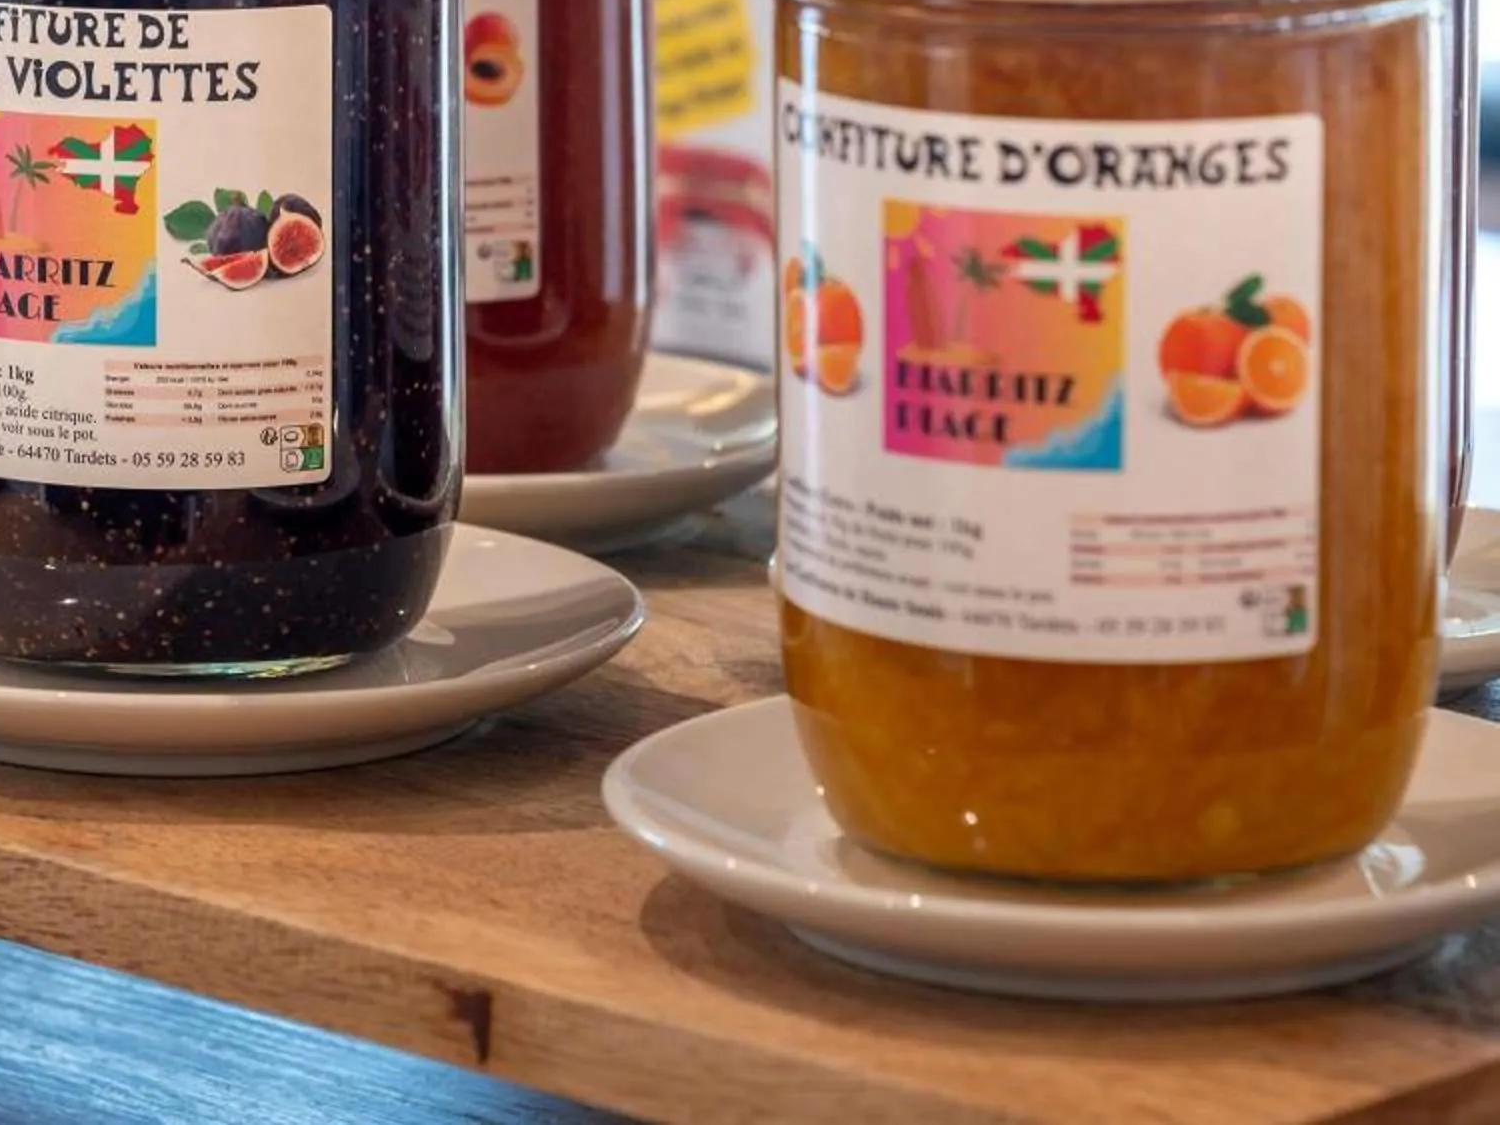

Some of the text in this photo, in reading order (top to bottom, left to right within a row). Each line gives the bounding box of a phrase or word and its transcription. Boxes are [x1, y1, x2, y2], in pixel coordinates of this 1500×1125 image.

[138, 12, 190, 49] DE
[997, 137, 1292, 191] D'ORANGES
[8, 364, 35, 386] 1kg
[5, 404, 38, 420] acide
[41, 408, 97, 426] citrique.
[1, 422, 25, 434] voir
[28, 425, 55, 438] sous
[58, 425, 70, 440] le
[17, 443, 60, 462] 64470
[63, 448, 117, 466] Tardets
[132, 451, 151, 468] 05
[156, 452, 176, 468] 59
[181, 452, 199, 468] 28
[204, 451, 223, 467] 59
[227, 450, 245, 466] 83
